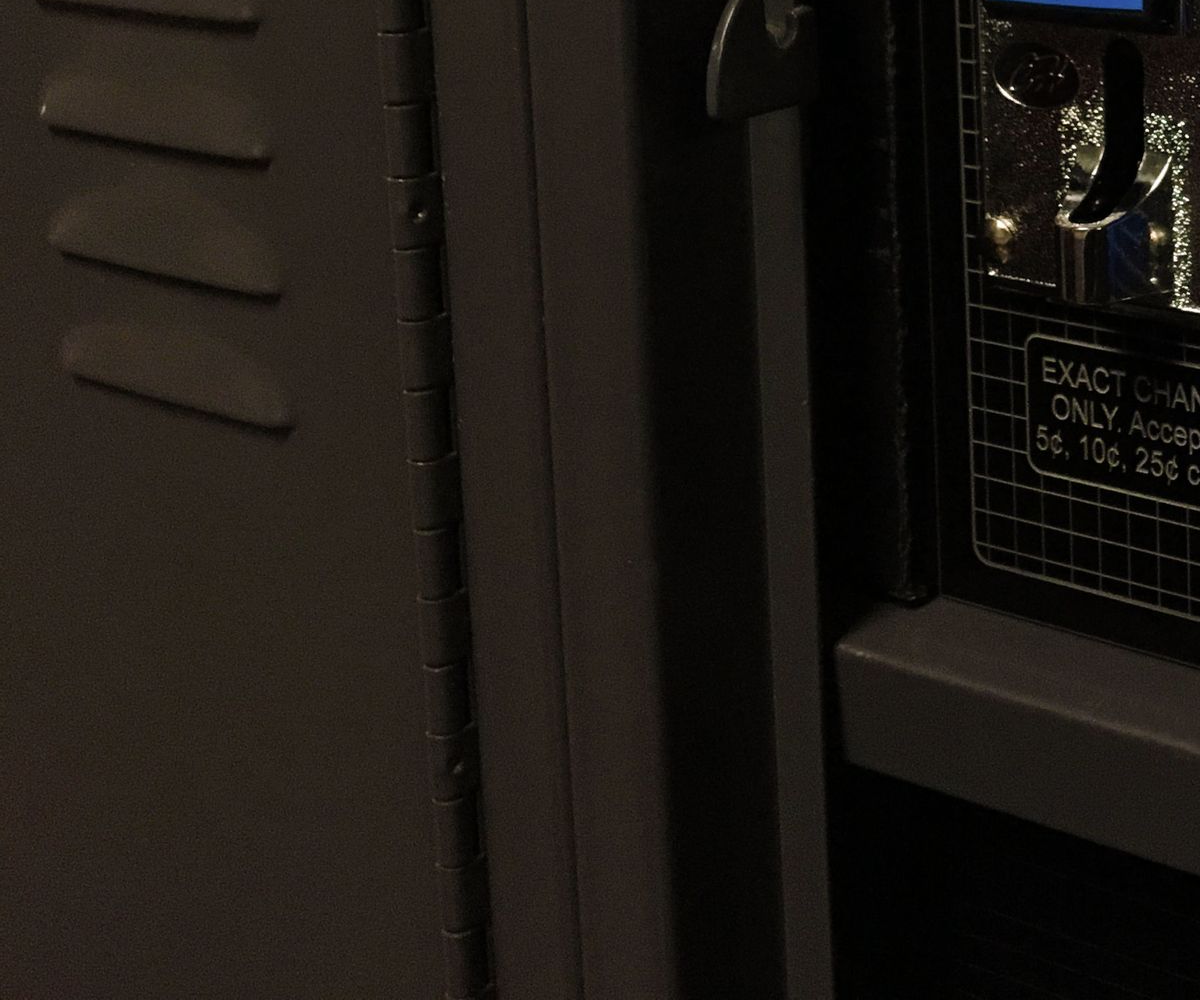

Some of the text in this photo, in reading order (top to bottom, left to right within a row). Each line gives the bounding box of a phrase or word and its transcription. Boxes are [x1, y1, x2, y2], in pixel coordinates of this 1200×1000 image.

[1041, 356, 1126, 397] EXACT
[1051, 393, 1122, 433] ONLY.
[1135, 446, 1180, 486] 25¢
